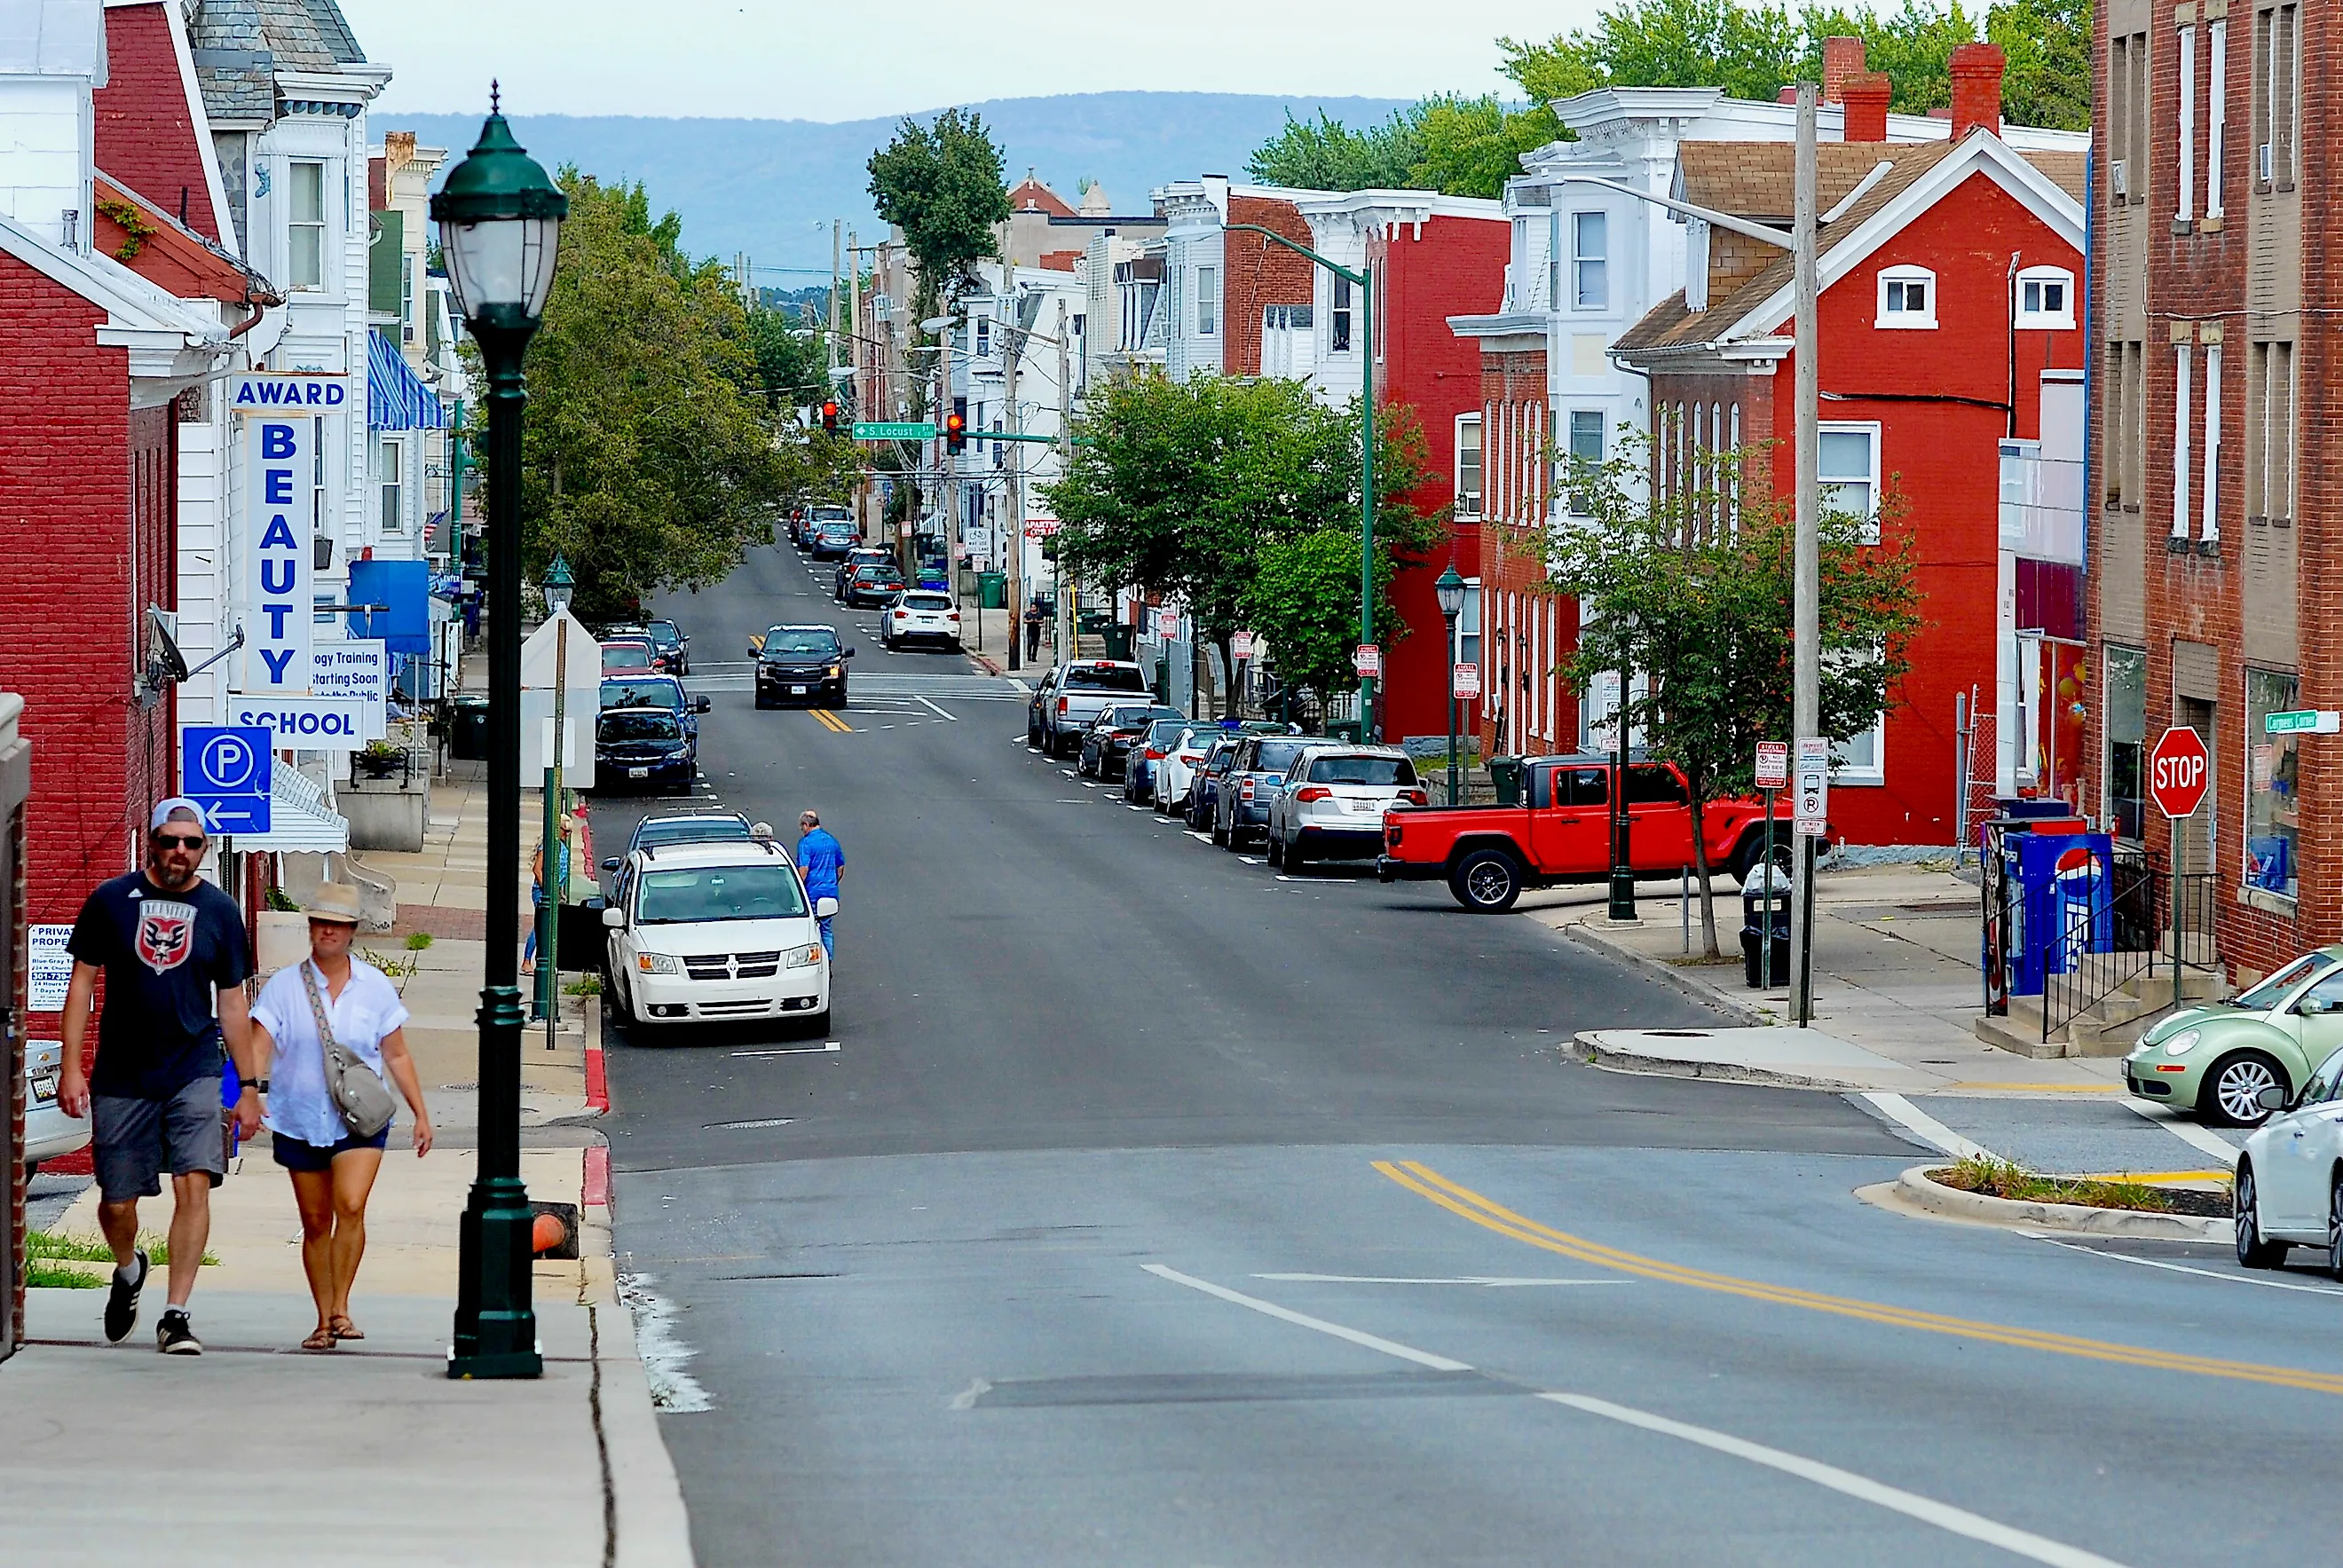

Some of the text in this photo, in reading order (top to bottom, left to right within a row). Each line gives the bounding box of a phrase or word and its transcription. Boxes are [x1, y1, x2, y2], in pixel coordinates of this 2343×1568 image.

[236, 382, 344, 406] AWARD
[870, 426, 878, 436] S.
[880, 426, 913, 436] Locust
[259, 424, 297, 684] BEAUTY
[335, 651, 378, 666] Training
[351, 672, 378, 684] Soon
[240, 711, 355, 736] SCHOOL
[2156, 755, 2205, 790] STOP
